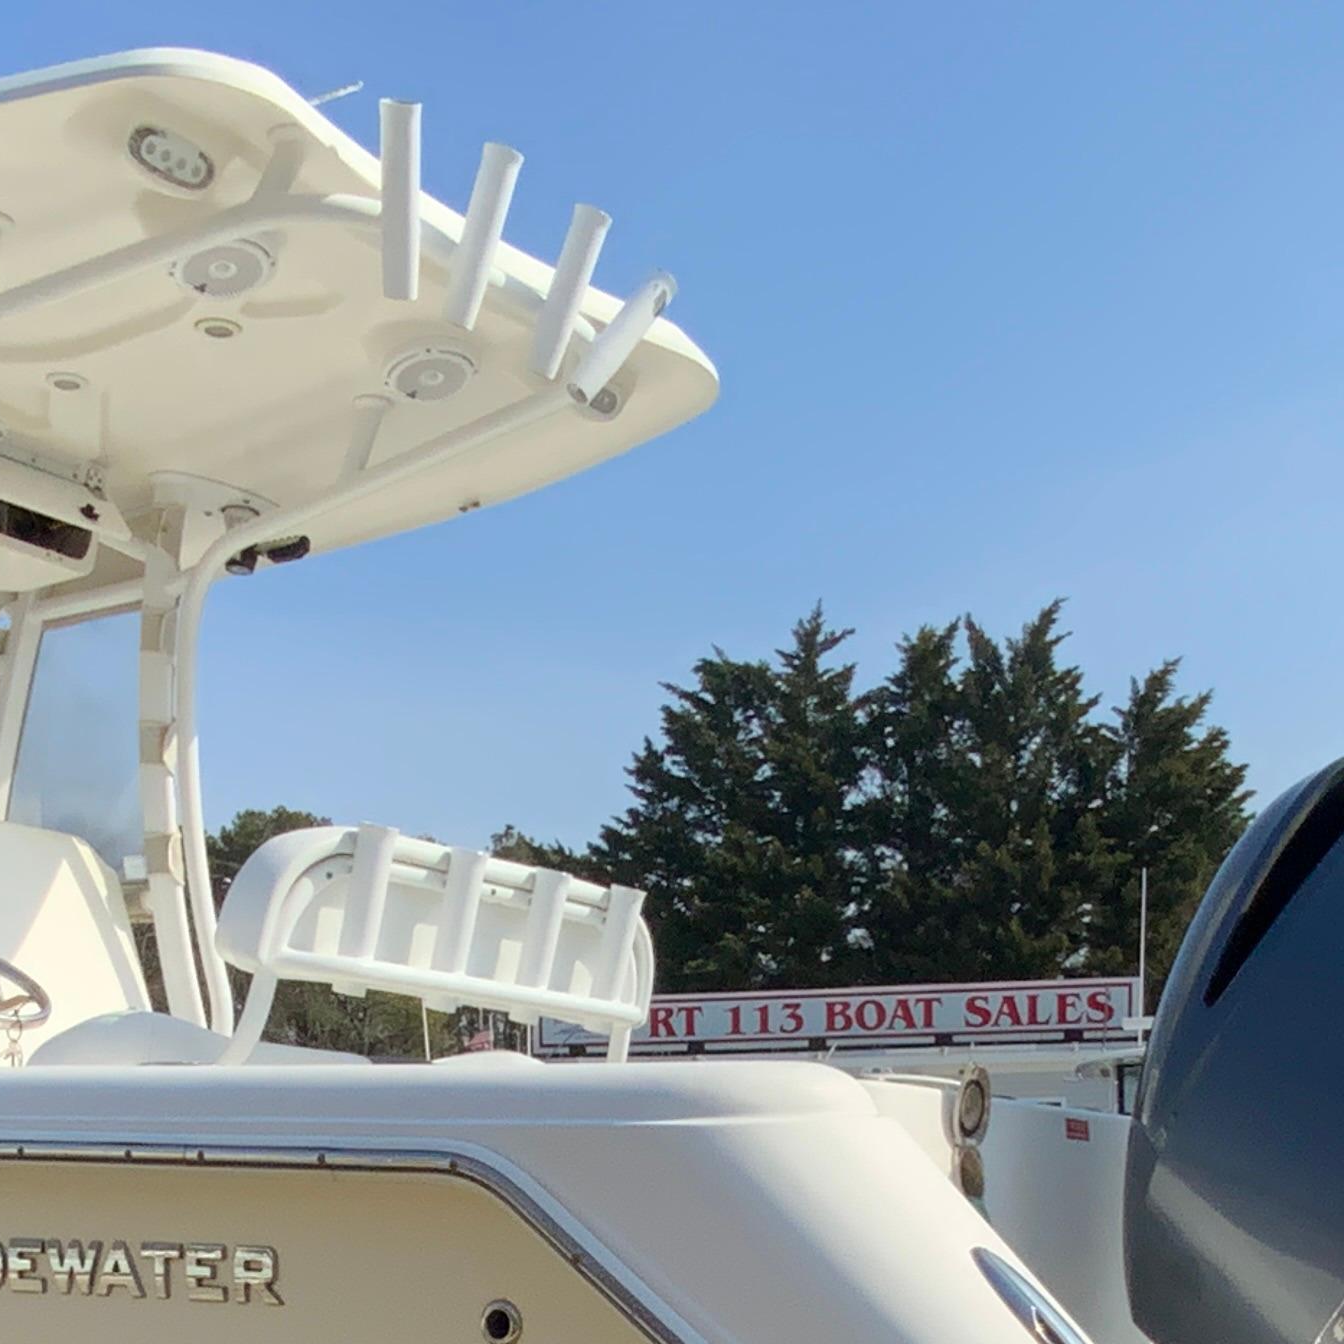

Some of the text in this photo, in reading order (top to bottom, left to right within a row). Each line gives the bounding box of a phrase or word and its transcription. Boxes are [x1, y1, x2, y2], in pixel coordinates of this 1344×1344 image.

[723, 1002, 804, 1036] 113
[824, 997, 942, 1032] BOAT
[964, 991, 1115, 1028] SALES
